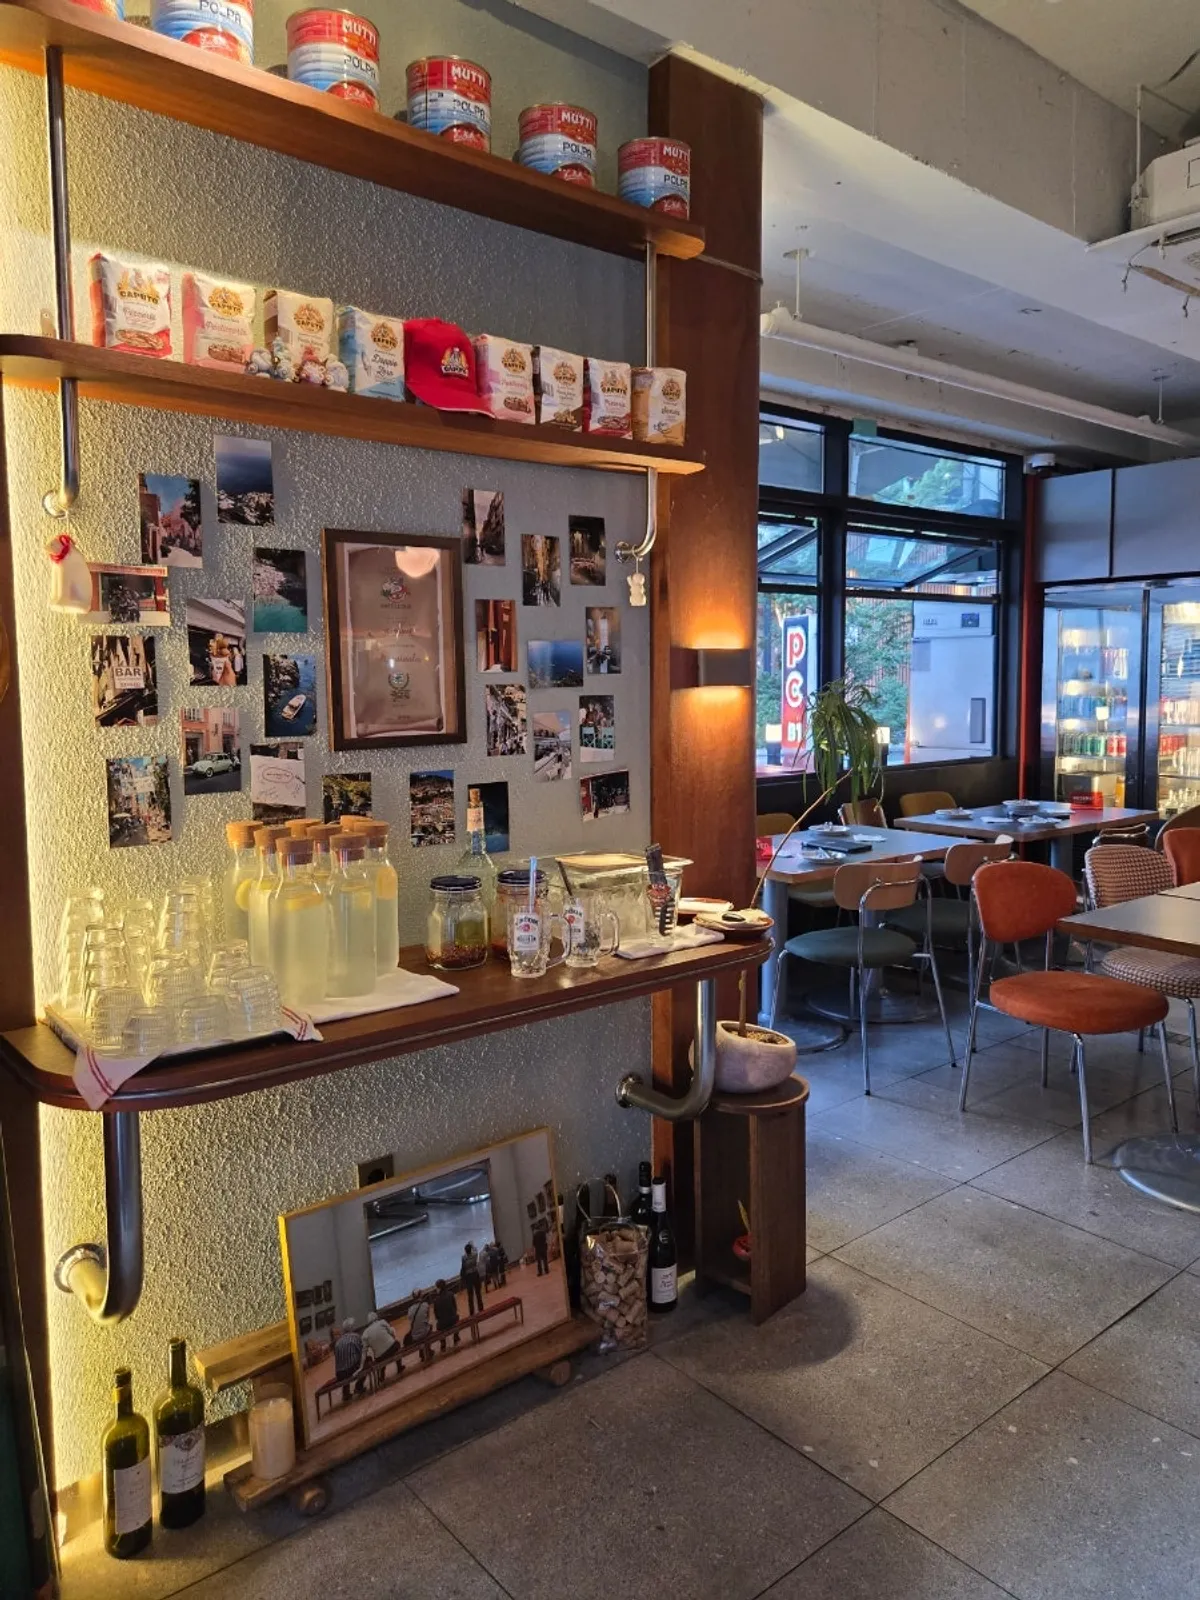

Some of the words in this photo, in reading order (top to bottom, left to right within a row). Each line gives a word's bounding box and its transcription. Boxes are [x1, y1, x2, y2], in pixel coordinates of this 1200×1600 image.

[342, 17, 377, 46] MUTTI
[343, 53, 376, 80] POLPA
[451, 64, 486, 88] MUTTI
[453, 99, 485, 119] POLPA
[561, 110, 593, 131] MUTTI
[563, 142, 592, 159] POLPA
[119, 290, 159, 305] CAPUTO
[115, 667, 142, 677] BAR
